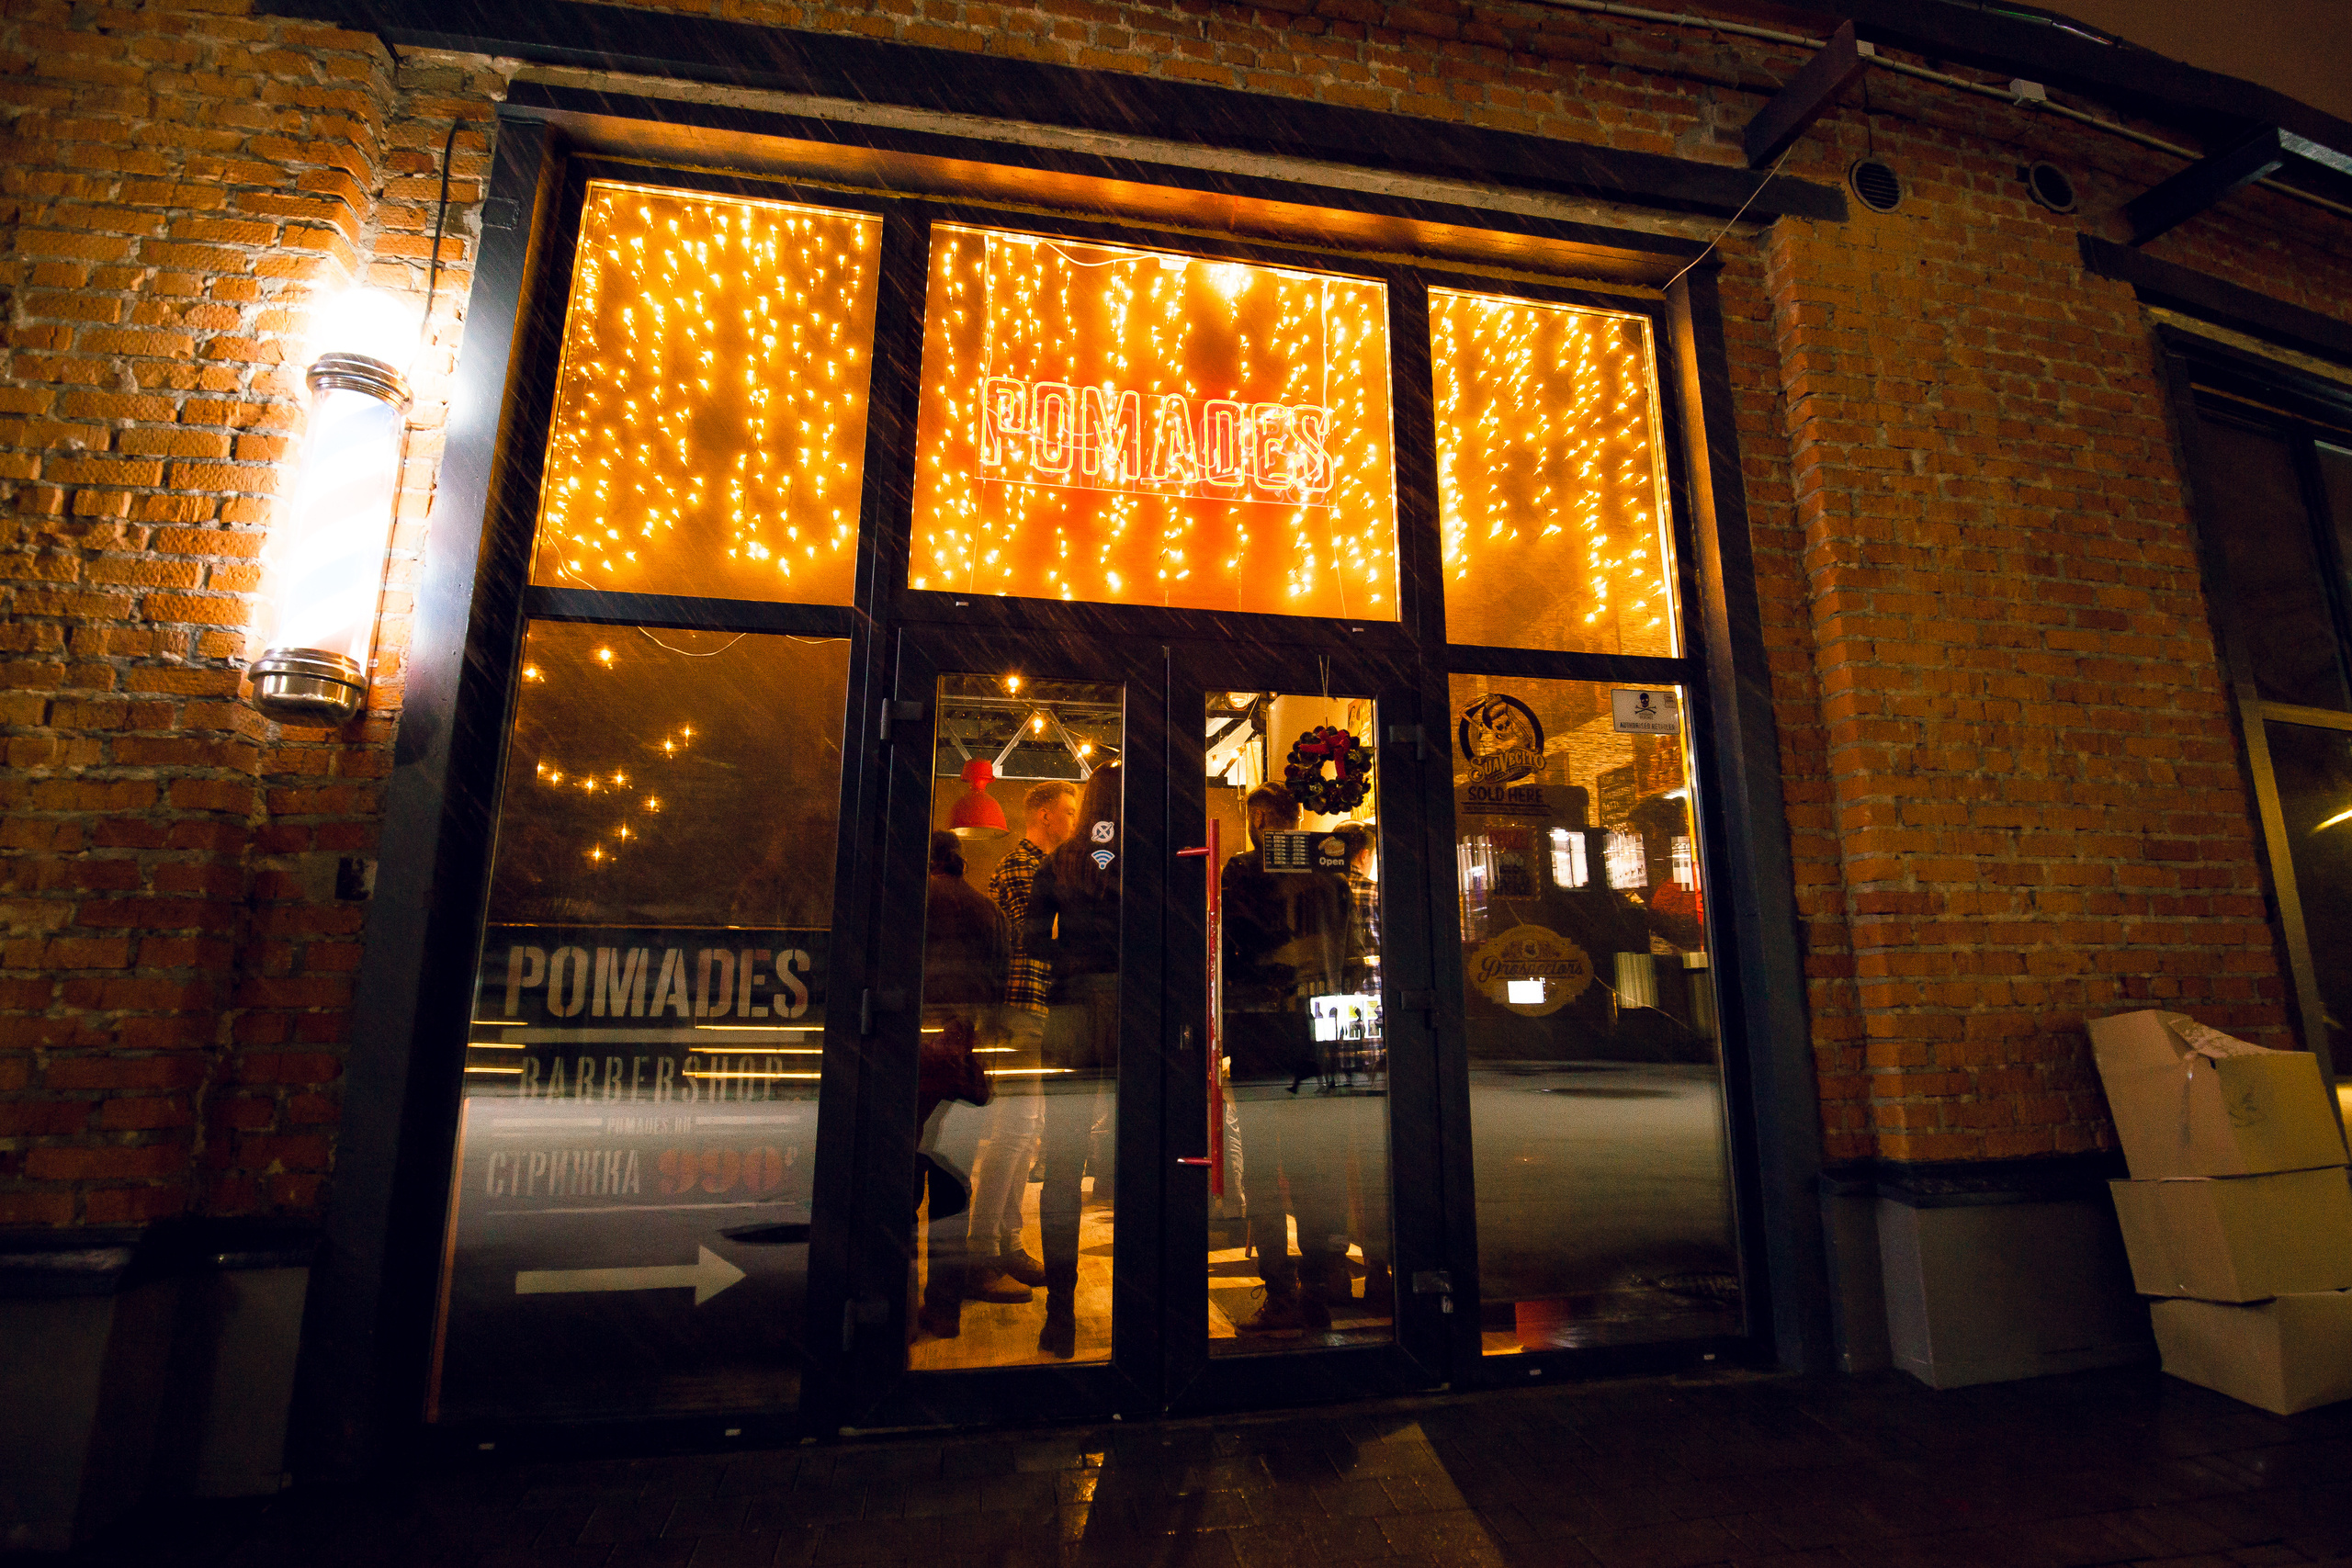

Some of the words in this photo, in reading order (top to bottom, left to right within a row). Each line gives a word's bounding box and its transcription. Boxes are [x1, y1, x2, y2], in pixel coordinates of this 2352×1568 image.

[980, 377, 1336, 492] POMADES
[1468, 785, 1504, 801] SOLD
[1509, 788, 1544, 803] HERE
[1318, 856, 1345, 867] Open
[504, 945, 811, 1019] POMADES
[518, 1055, 784, 1105] BARBERSHOP
[486, 1148, 641, 1197] СТРИЖКА
